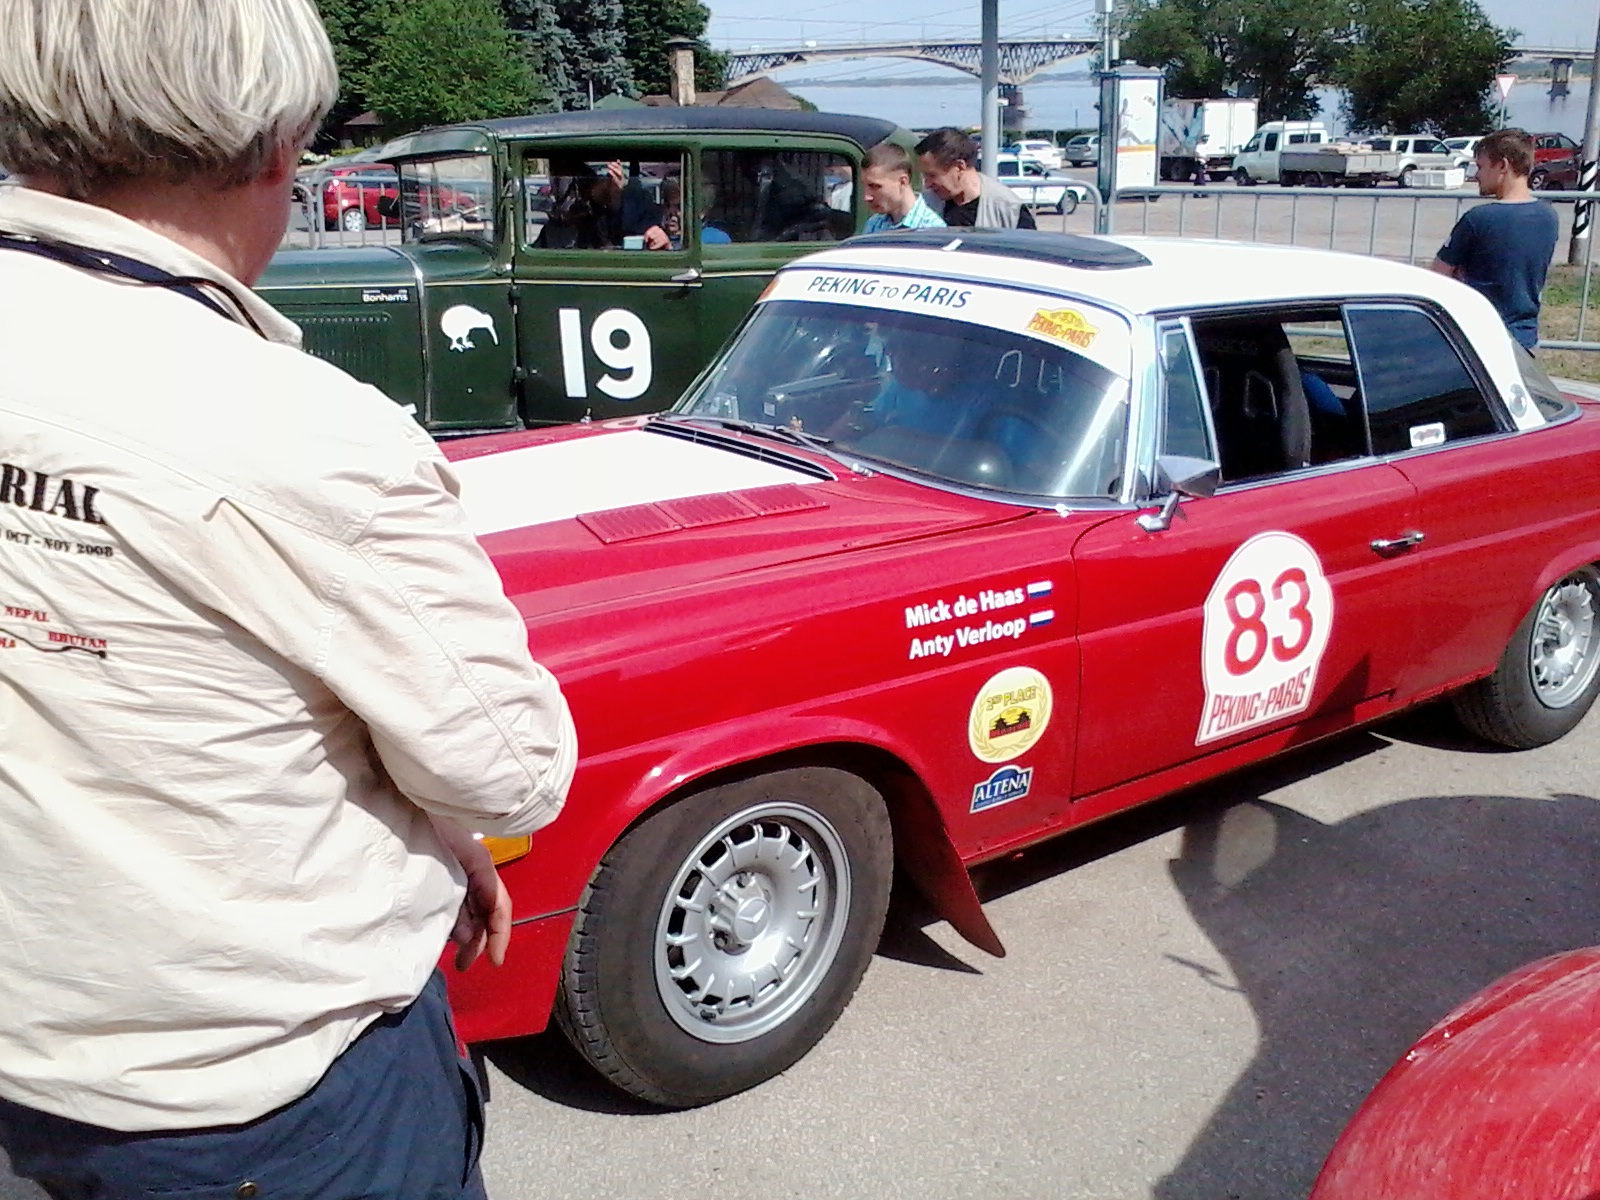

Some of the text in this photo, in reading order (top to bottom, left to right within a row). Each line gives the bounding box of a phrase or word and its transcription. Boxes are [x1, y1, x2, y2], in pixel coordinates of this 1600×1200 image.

[362, 293, 408, 302] Bonhams
[807, 276, 973, 308] PEKING TO PARIS
[559, 308, 653, 400] 19
[0, 463, 108, 526] RIAL
[76, 543, 114, 557] 2008
[5, 605, 49, 622] NEPAL
[905, 588, 1025, 629] Mick de Haas
[1224, 567, 1313, 676] 83
[48, 631, 107, 648] BHUTAN
[909, 618, 1026, 660] Anty Verloop
[1003, 685, 1037, 707] PLACE
[1206, 665, 1312, 735] PEKING PARIS
[975, 773, 1028, 803] ALTENA
